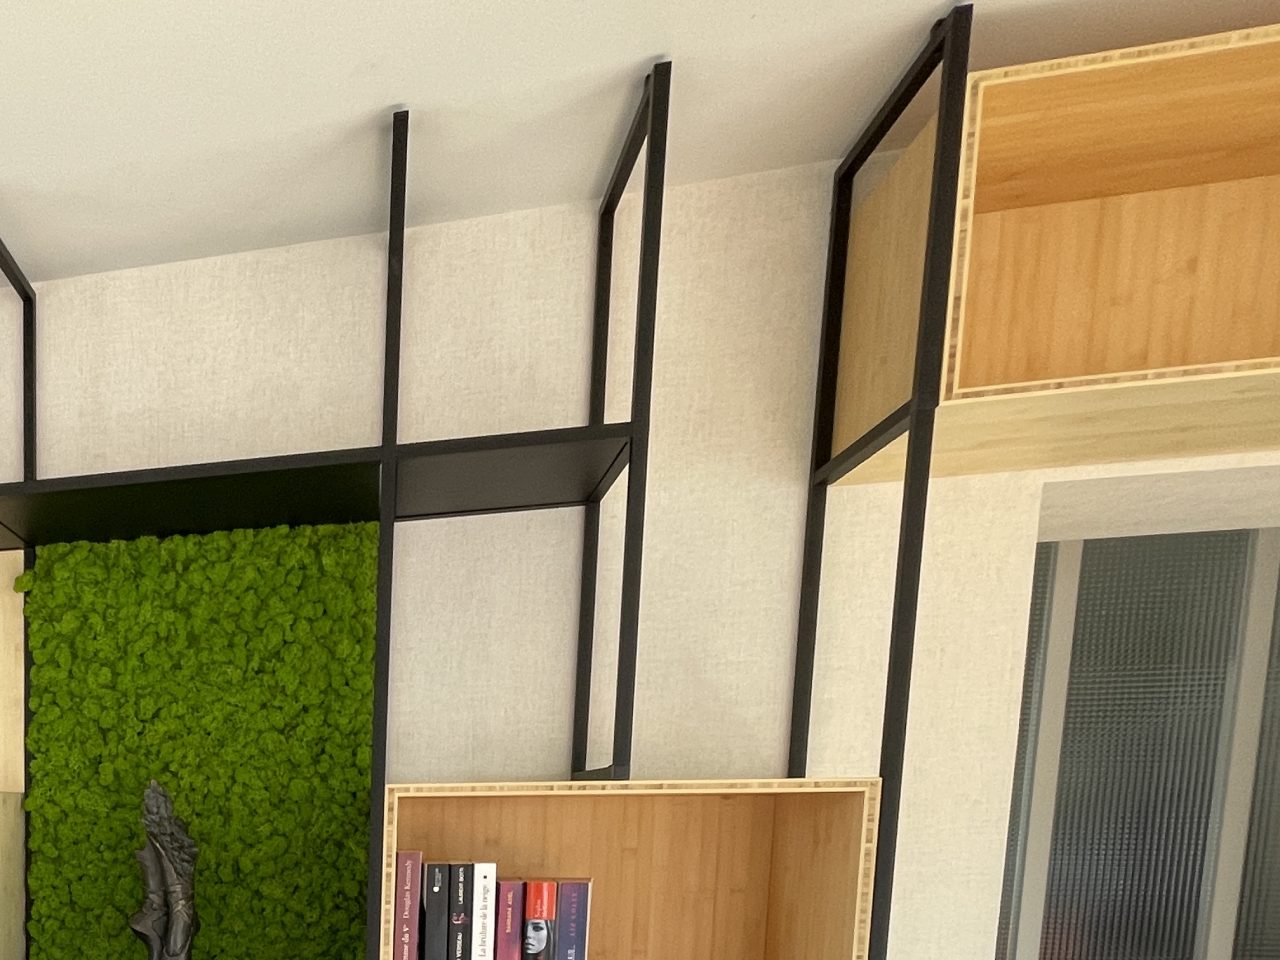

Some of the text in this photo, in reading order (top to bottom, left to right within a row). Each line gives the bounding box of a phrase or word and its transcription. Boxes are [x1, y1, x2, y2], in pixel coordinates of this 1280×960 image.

[402, 860, 413, 918] Douglas Kennedy
[479, 912, 487, 920] de
[402, 933, 409, 943] du
[455, 932, 463, 957] VERSEAU
[478, 948, 486, 957] La
